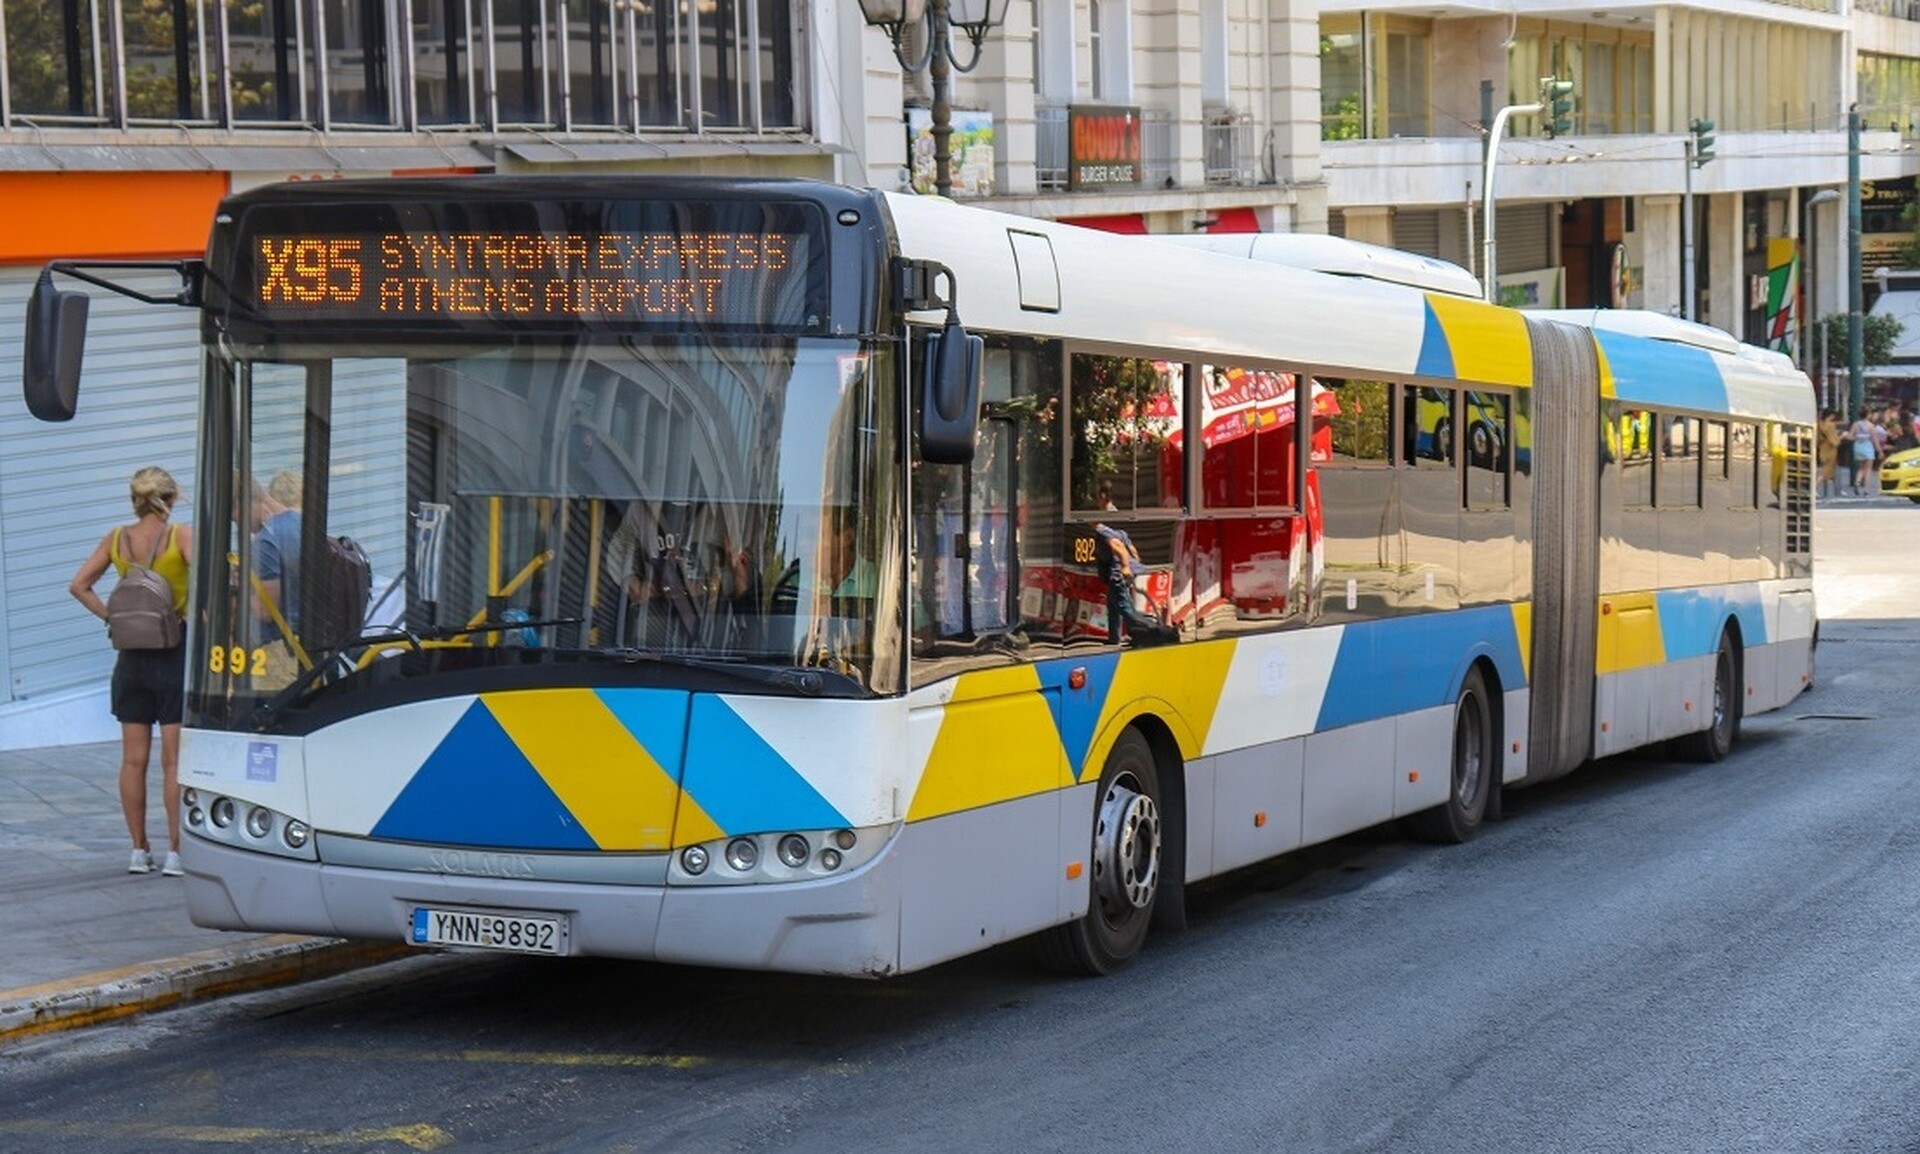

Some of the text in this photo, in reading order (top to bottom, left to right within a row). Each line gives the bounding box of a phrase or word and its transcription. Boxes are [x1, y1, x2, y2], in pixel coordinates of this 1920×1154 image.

[1074, 114, 1140, 160] GOODY'S
[1081, 165, 1133, 182] BURGER HOUSE
[380, 234, 787, 270] SYNTAGMA EXPRESS
[262, 239, 361, 301] X95
[380, 277, 722, 312] ATHENS AIRPORT
[1075, 538, 1096, 562] 892
[210, 645, 267, 676] 892
[430, 851, 537, 877] SOLARIS
